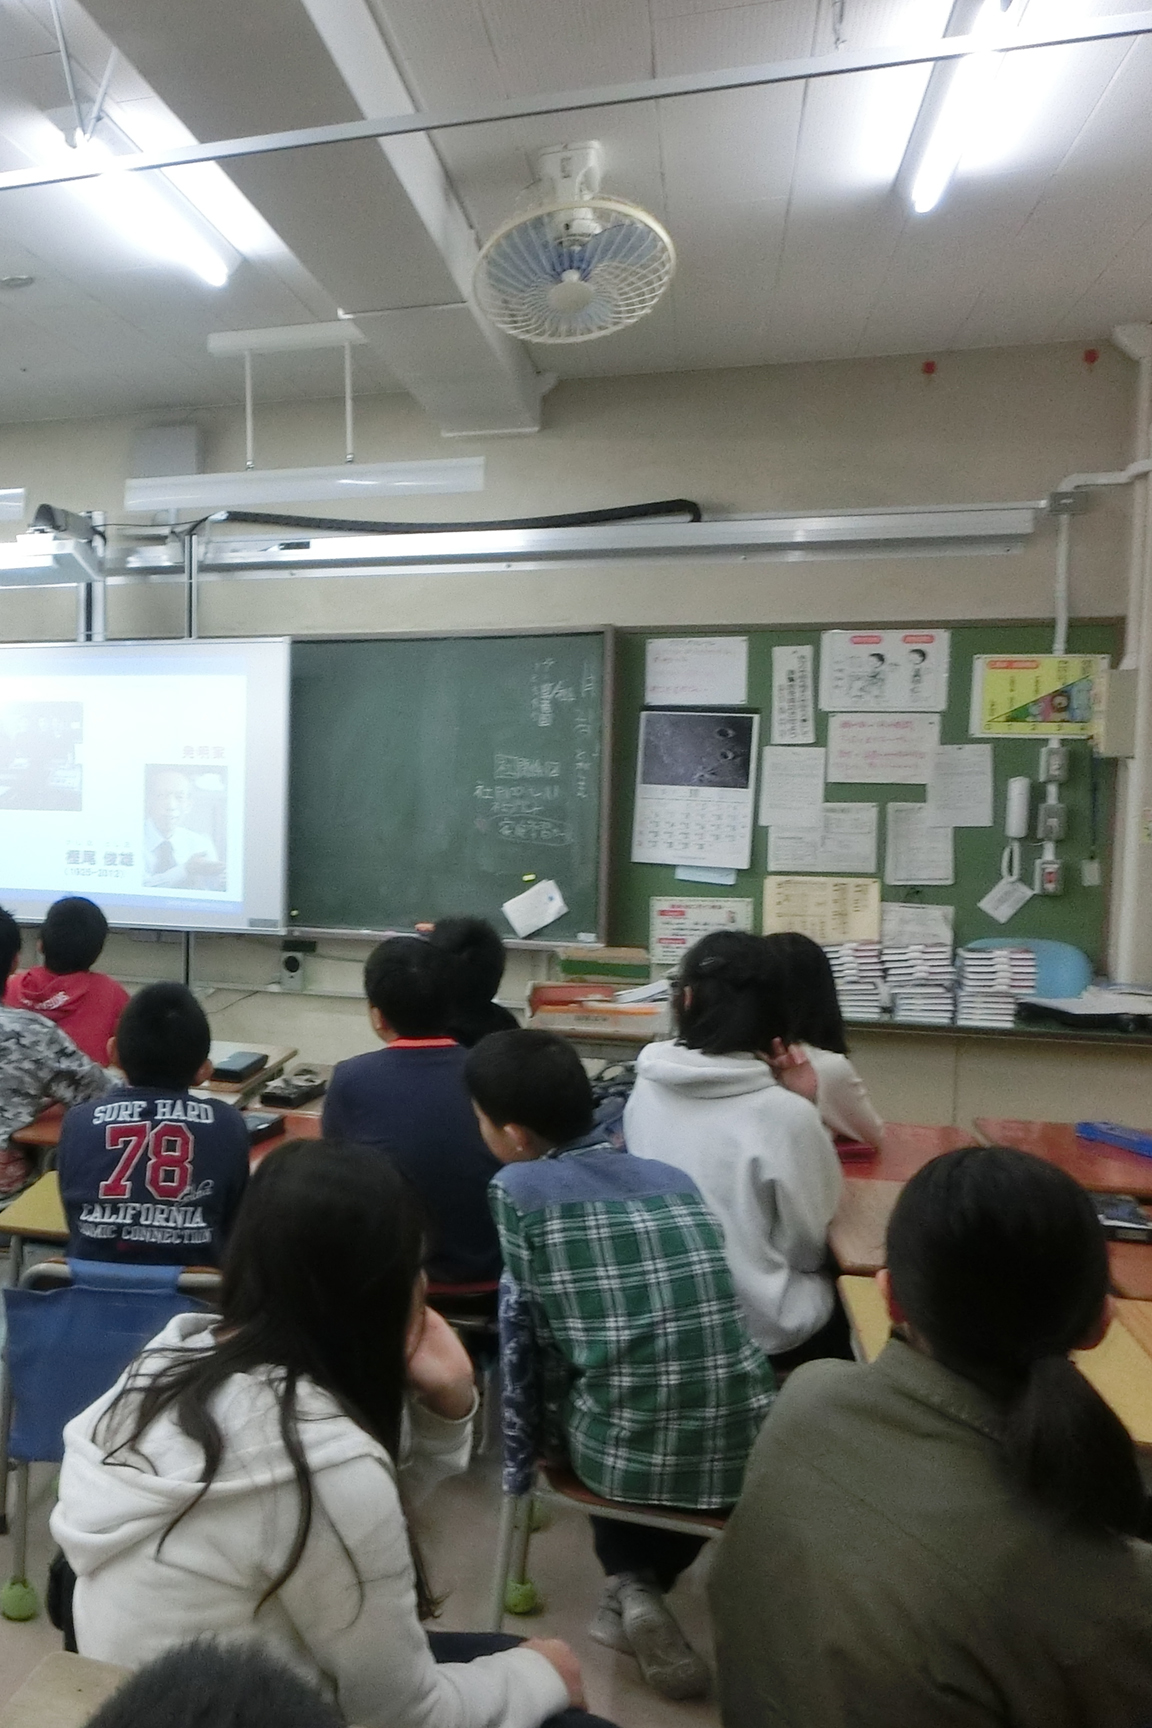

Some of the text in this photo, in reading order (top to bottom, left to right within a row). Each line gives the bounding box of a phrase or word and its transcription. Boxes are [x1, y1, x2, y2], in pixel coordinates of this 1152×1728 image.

[92, 1099, 215, 1125] SURF HARD
[98, 1120, 195, 1201] 78
[79, 1203, 207, 1228] CALIFORNIA
